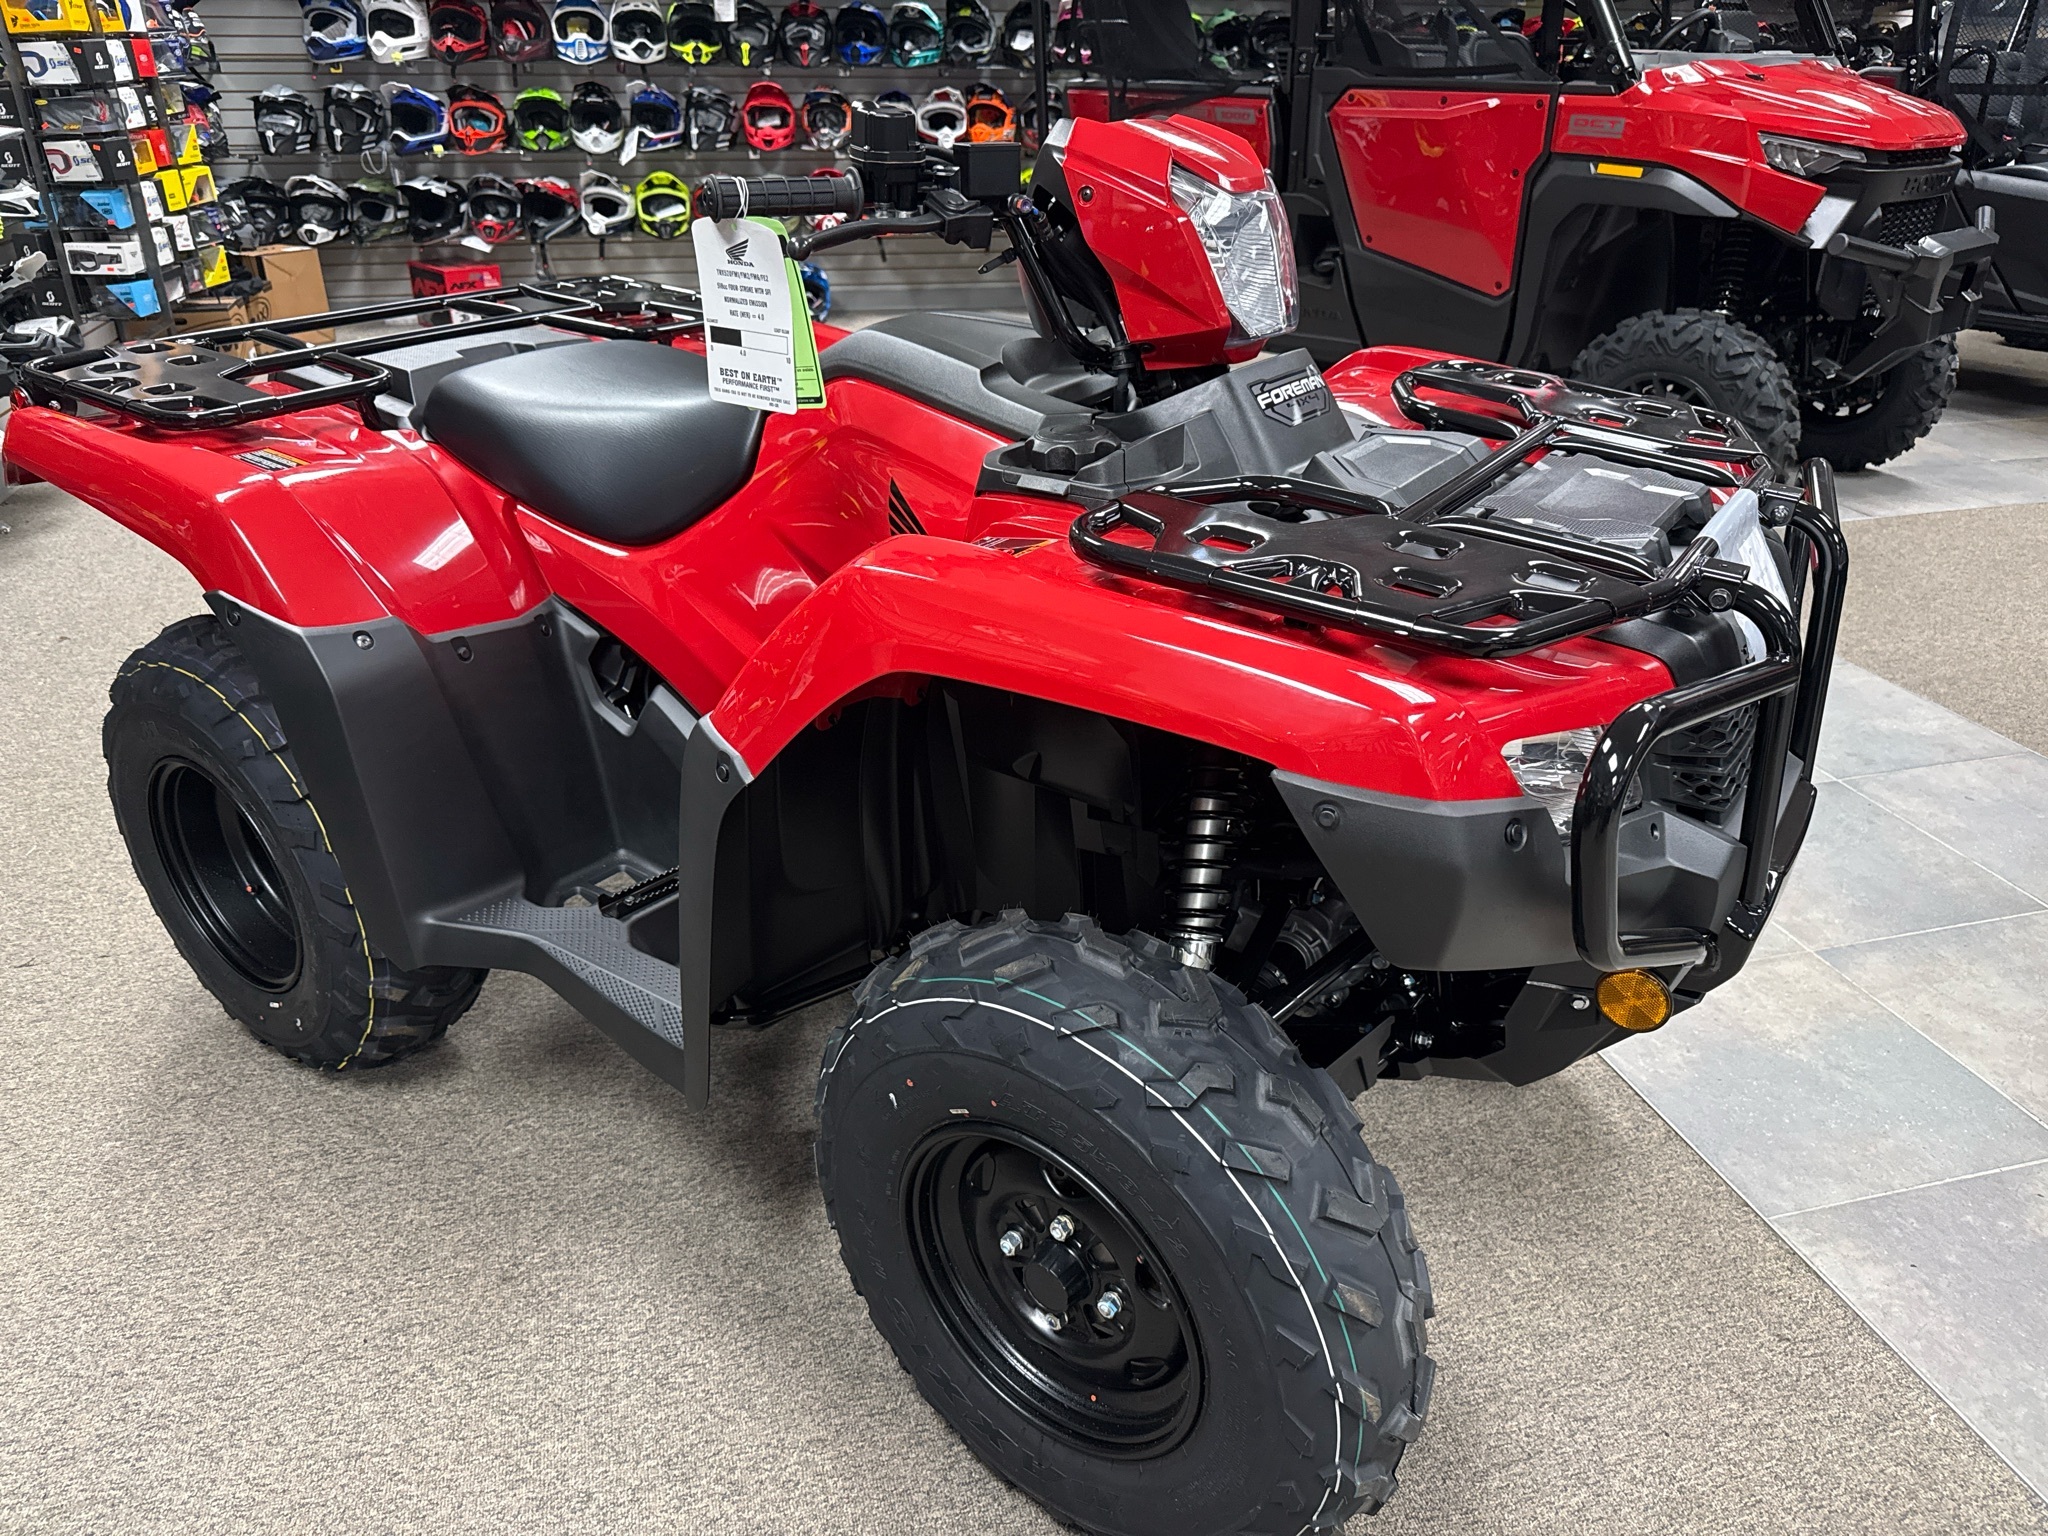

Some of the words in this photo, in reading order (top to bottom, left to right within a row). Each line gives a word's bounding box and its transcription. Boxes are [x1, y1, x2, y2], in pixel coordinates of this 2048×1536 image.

[1574, 118, 1622, 129] DCT
[727, 259, 755, 268] HONDA
[450, 281, 477, 291] AFX
[724, 296, 748, 306] NORMALIZED
[749, 299, 767, 308] EMISSION
[730, 309, 739, 318] RATE
[710, 344, 714, 352] 0
[739, 349, 747, 357] 4.0
[719, 367, 739, 378] BEST
[741, 371, 751, 380] ON
[722, 378, 759, 390] PERFORMANCE
[1257, 374, 1326, 410] FOREMAN
